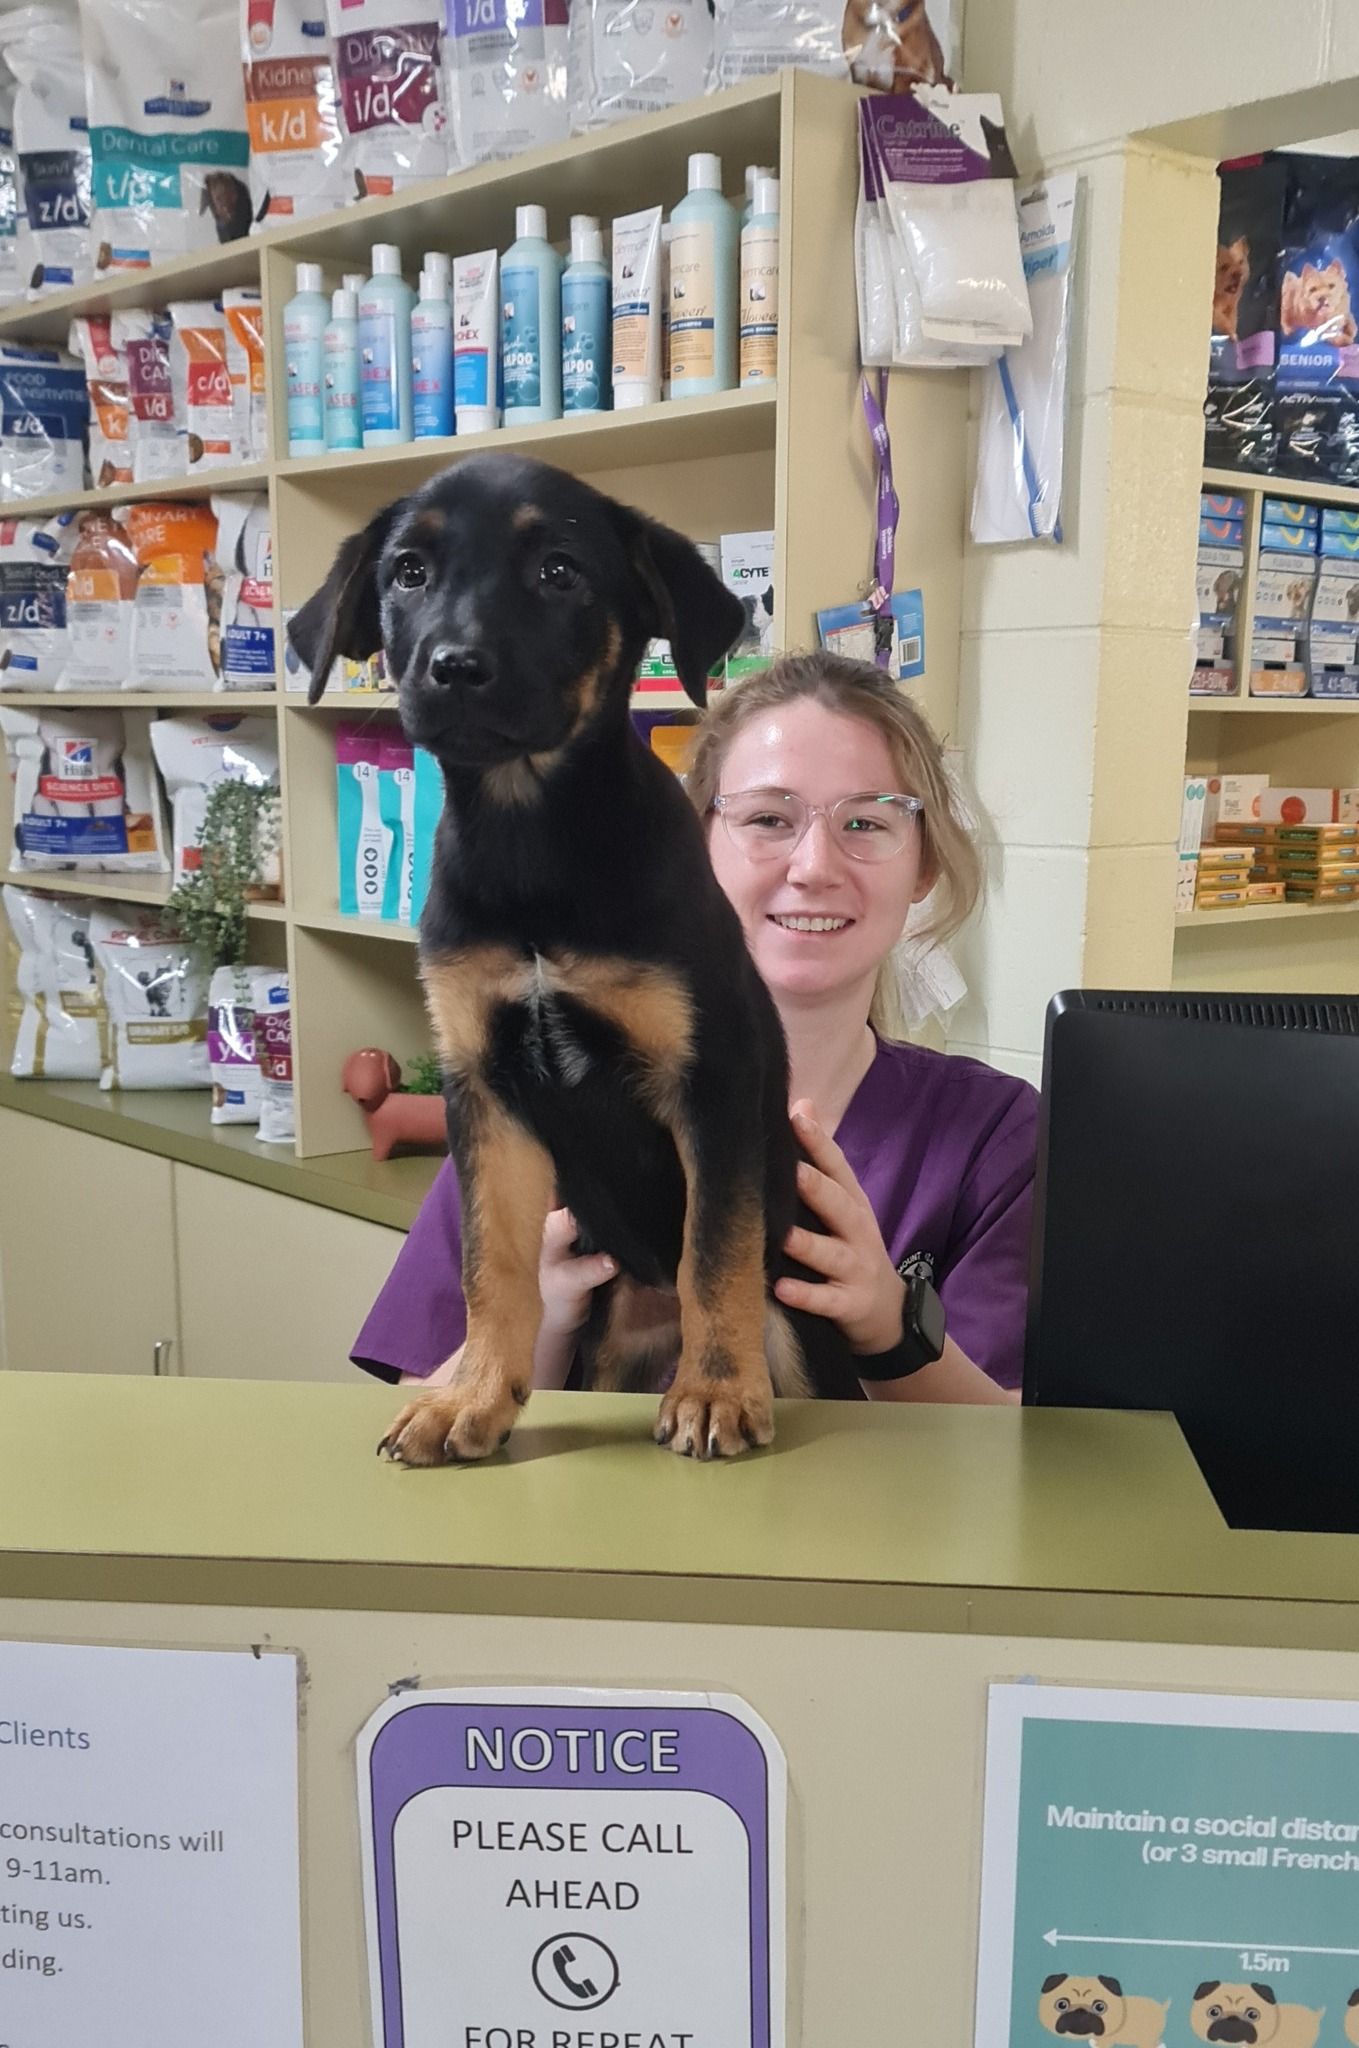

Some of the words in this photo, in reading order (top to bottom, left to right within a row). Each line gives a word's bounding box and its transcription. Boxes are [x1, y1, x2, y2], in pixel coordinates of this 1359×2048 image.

[257, 66, 313, 88] Kidne
[354, 84, 390, 122] i/d
[261, 111, 307, 143] k/d
[102, 130, 166, 157] Dental
[172, 137, 218, 154] Care
[39, 193, 79, 223] z/d
[1280, 353, 1333, 367] SENIOR
[733, 566, 769, 579] 4CYTE
[7, 600, 40, 623] z/d
[356, 765, 370, 778] 14
[397, 771, 411, 782] 14
[46, 781, 89, 792] SCIENCE
[93, 781, 117, 791] DIET
[0, 1721, 91, 1750] Clients
[465, 1726, 681, 1774] NOTICE
[1046, 1805, 1165, 1834] Maintain
[1170, 1815, 1190, 1834] a
[1194, 1815, 1276, 1839] social
[0, 1821, 171, 1851] consultations
[179, 1830, 224, 1853] will
[453, 1819, 589, 1852] PLEASE
[601, 1823, 694, 1854] CALL
[1141, 1841, 1181, 1865] (or
[1181, 1844, 1198, 1863] 3
[1202, 1845, 1267, 1867] small
[6, 1857, 112, 1886] 9-11am.
[506, 1879, 640, 1910] AHEAD
[58, 1909, 93, 1930] us.
[2, 1948, 64, 1977] ding.
[1239, 1952, 1290, 1973] 1.5m
[465, 2026, 536, 2048] FOR
